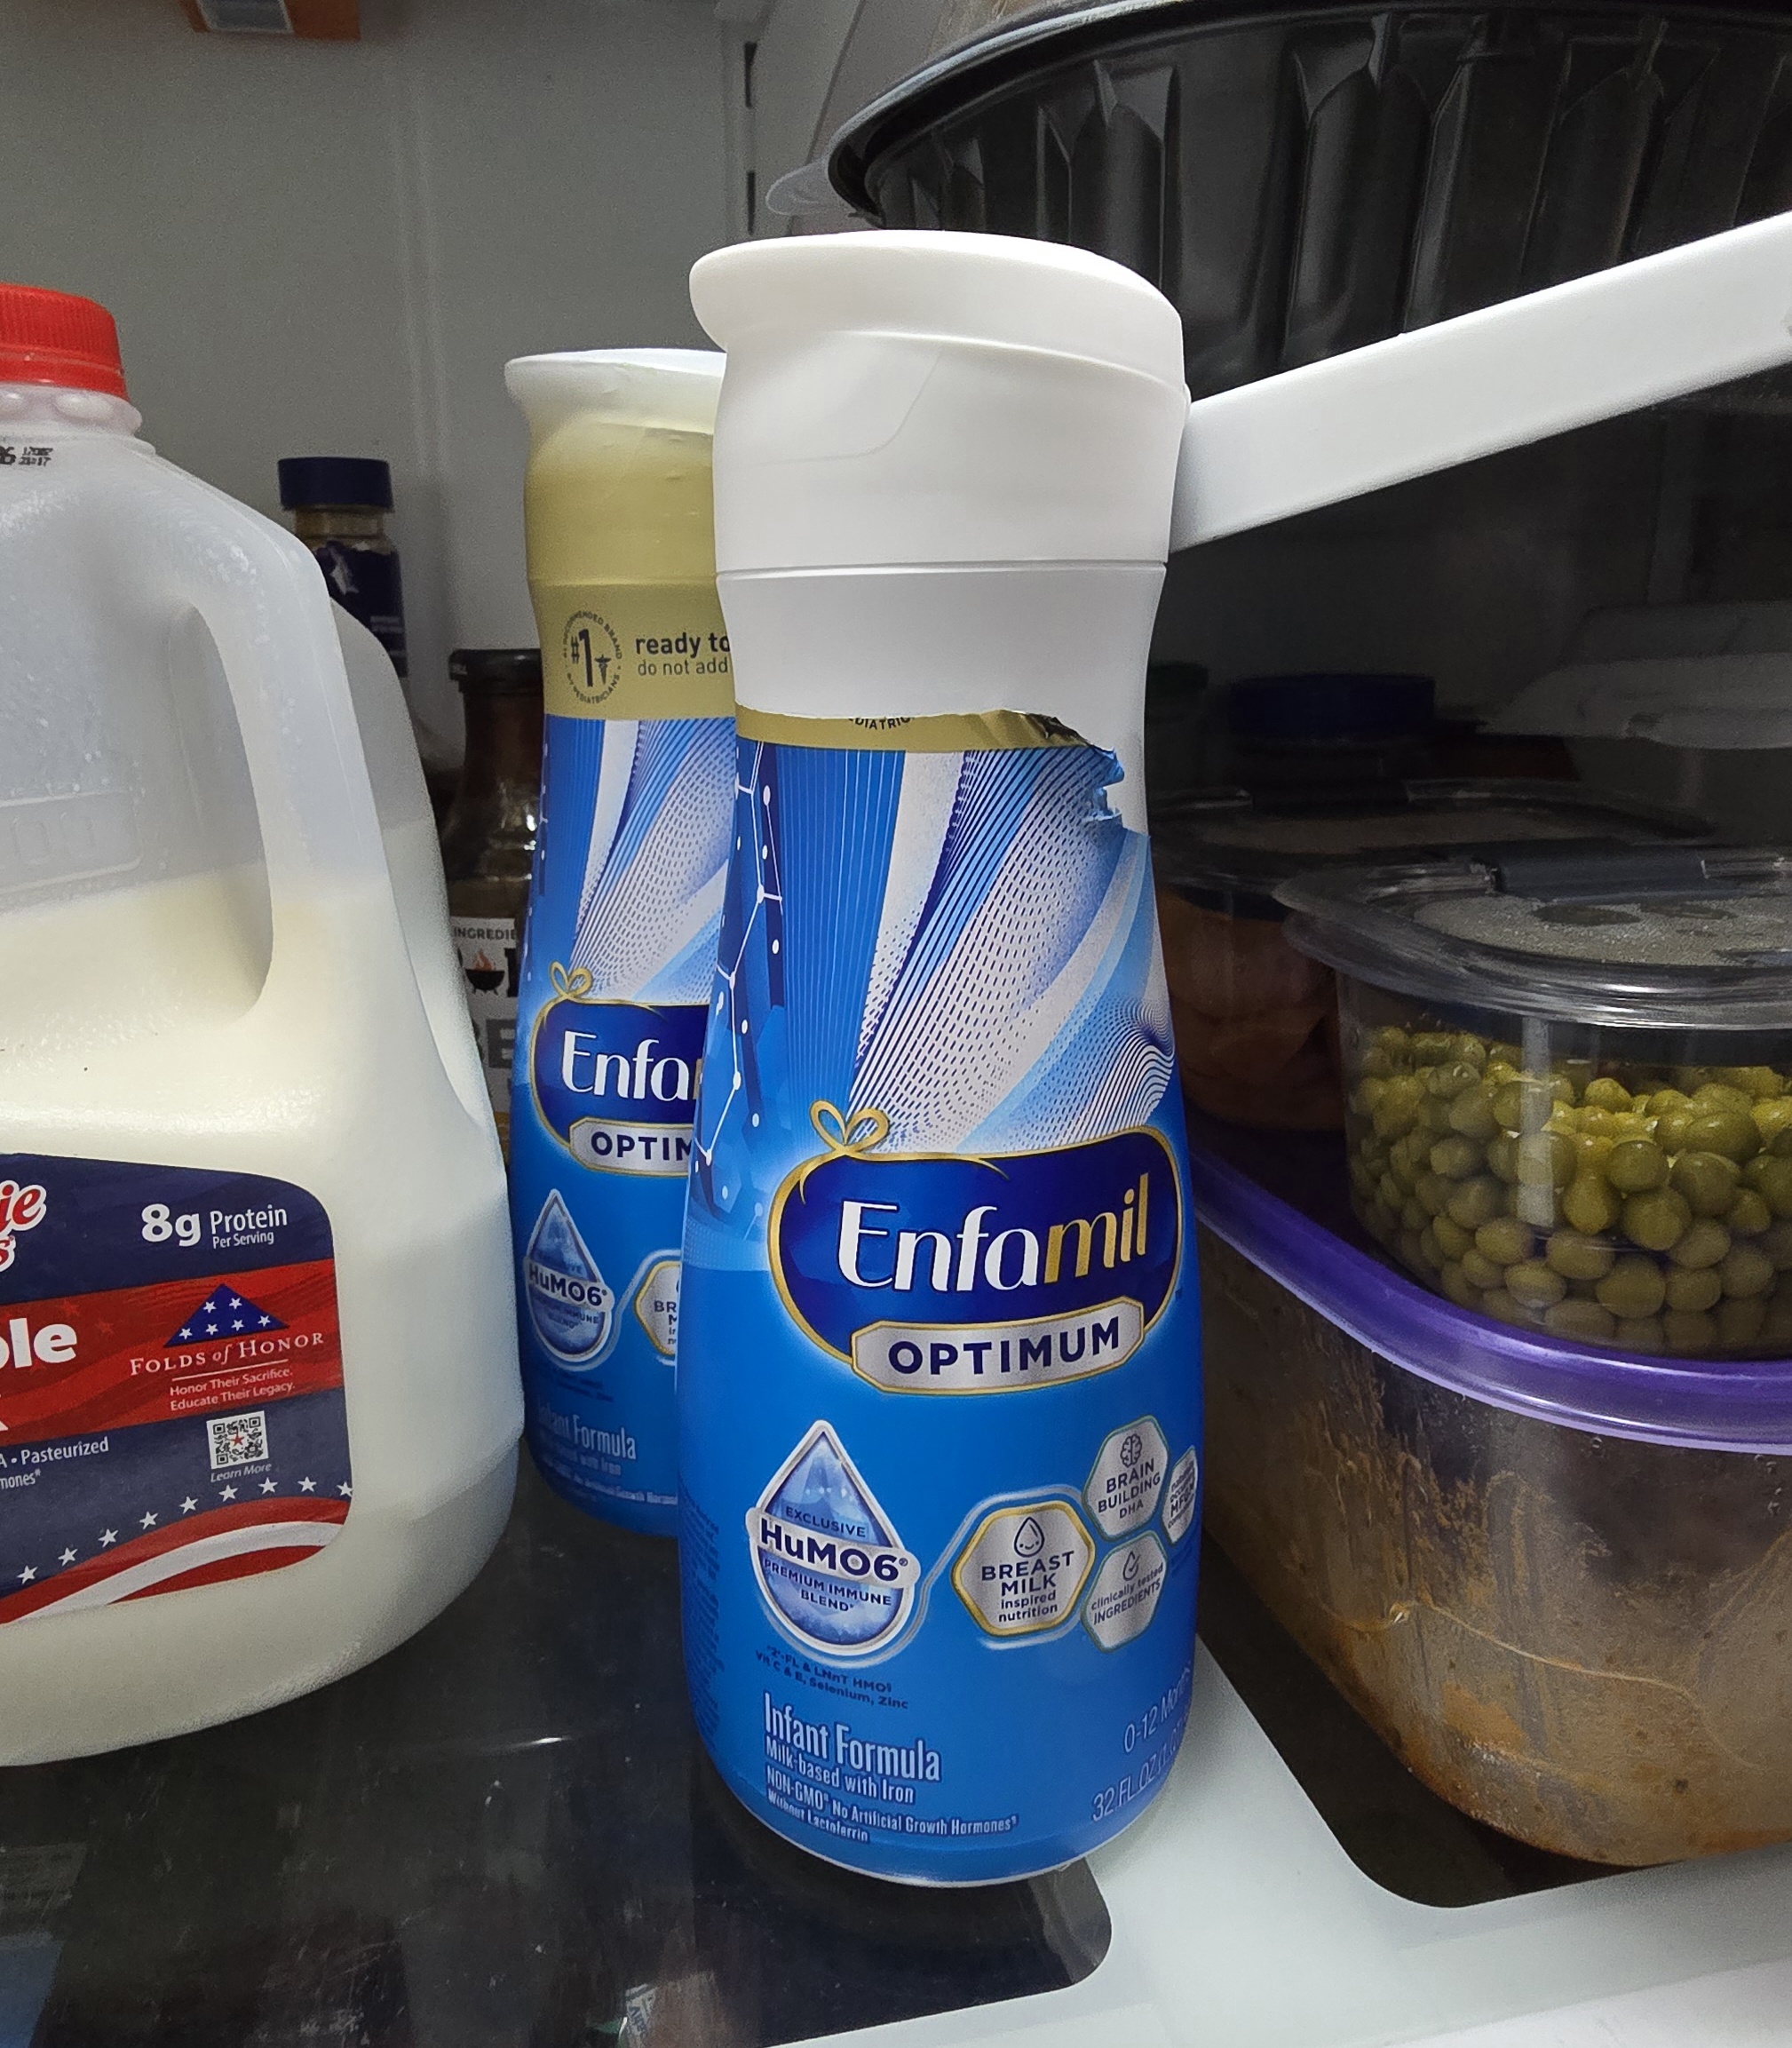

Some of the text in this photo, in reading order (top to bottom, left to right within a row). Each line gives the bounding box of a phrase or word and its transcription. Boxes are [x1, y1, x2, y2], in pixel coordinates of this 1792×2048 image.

[635, 631, 701, 658] ready
[638, 657, 728, 676] do not add
[141, 1203, 288, 1247] 8g Protein
[212, 1232, 274, 1250] Per Serving
[837, 1171, 1150, 1292] Enfamil
[130, 1331, 325, 1376] FOLDS of HONOR
[887, 1314, 1120, 1377] OPTIMUM
[170, 1369, 293, 1396] Honor Their Sacrifice.
[170, 1383, 296, 1411] Educate Their Legacy.
[20, 1435, 109, 1465] Pasteurized
[573, 1414, 638, 1460] Formula
[210, 1462, 272, 1483] Learn More
[1106, 1458, 1154, 1494] BRAIN
[1098, 1472, 1162, 1513] BUILDING
[785, 1505, 867, 1538] EXCLUSIVE
[1119, 1501, 1144, 1520] DHA
[764, 1558, 892, 1606] PREMIUM IMMUNE
[981, 1551, 1074, 1581] BREAST
[1001, 1573, 1057, 1597] MILK
[1001, 1590, 1057, 1610] inspired
[1090, 1564, 1164, 1611] clinically tested
[1093, 1578, 1162, 1625] INGREDIENTS
[998, 1603, 1059, 1623] nutrition
[877, 1695, 909, 1710] Zinc
[764, 1692, 941, 1782] Infant Formula
[1123, 1705, 1158, 1754] 0-12
[765, 1734, 914, 1804] Milk-based with Iron
[832, 1798, 848, 1820] No
[851, 1805, 902, 1832] Artificial
[905, 1815, 948, 1836] Growth
[1092, 1787, 1115, 1822] 32
[807, 1808, 869, 1843] Lactoferrin
